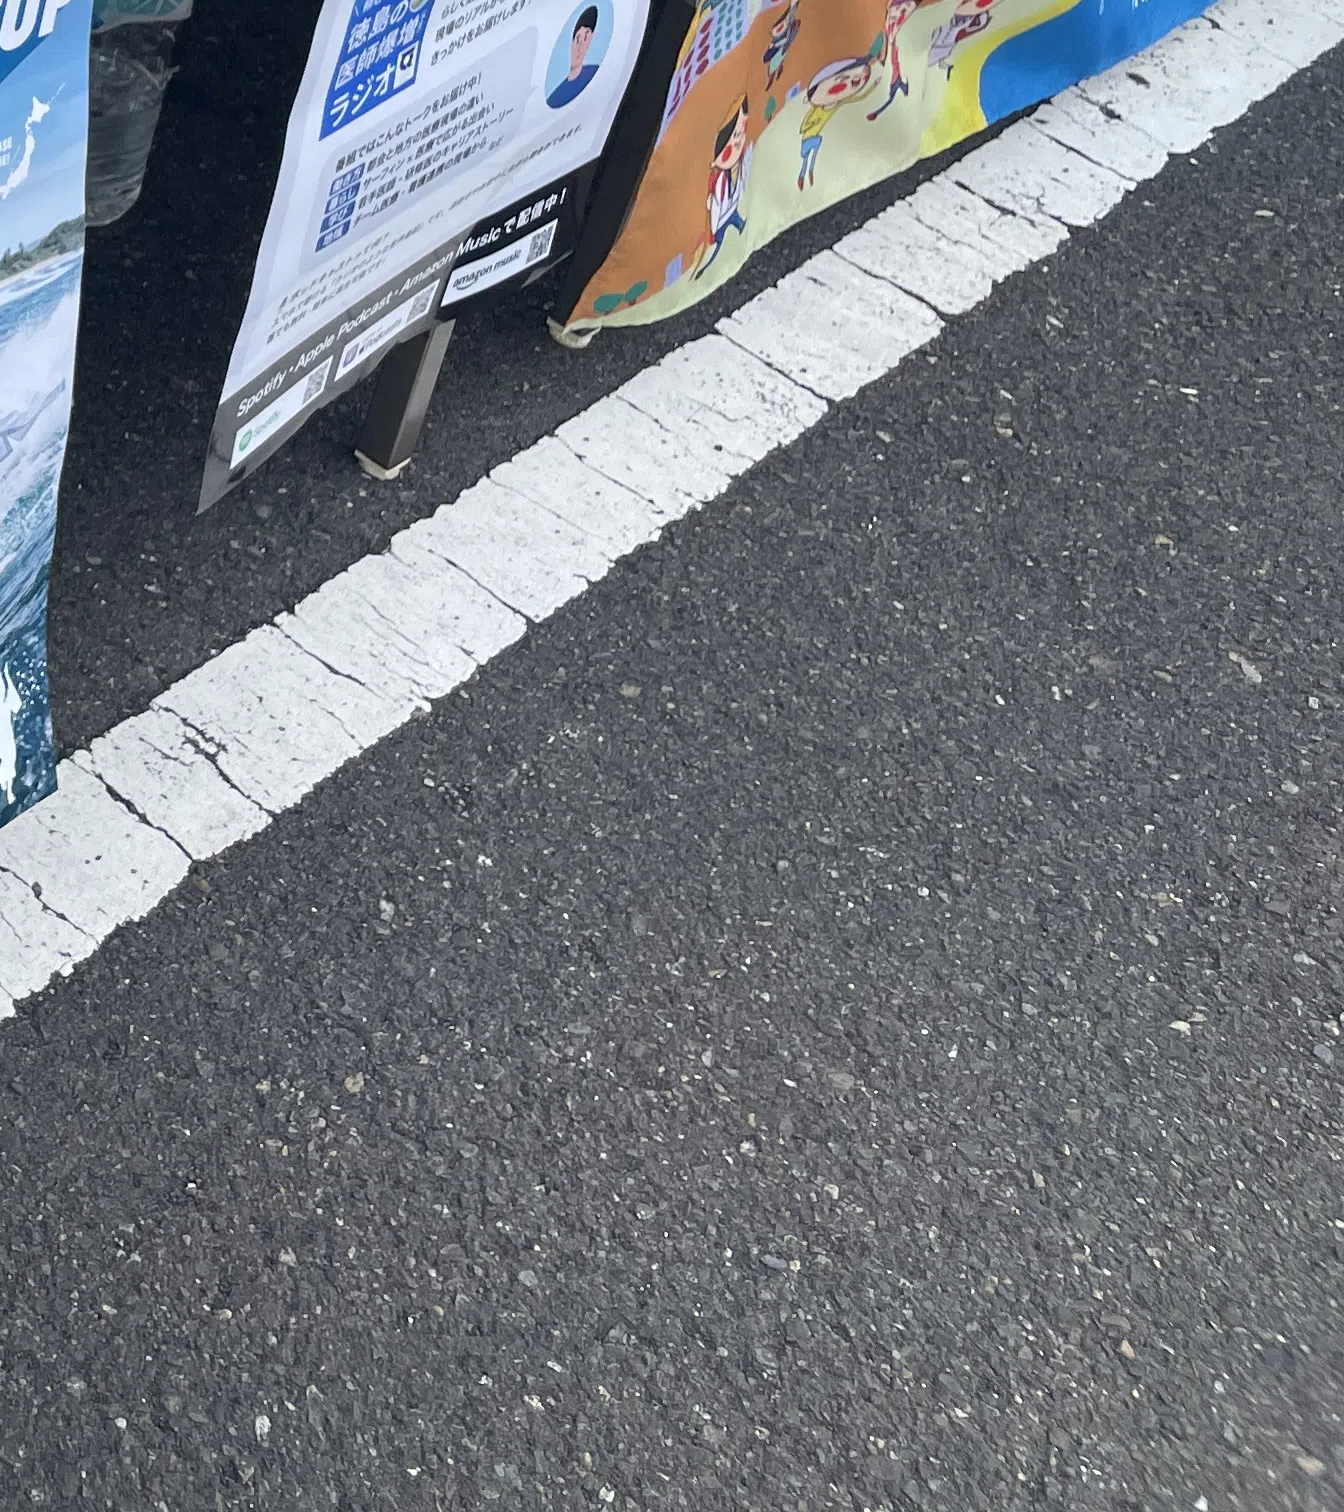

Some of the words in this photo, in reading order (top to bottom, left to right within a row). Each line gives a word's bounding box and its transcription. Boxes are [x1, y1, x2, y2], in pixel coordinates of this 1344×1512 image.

[329, 62, 395, 128] ラジオ
[456, 225, 503, 260] Music
